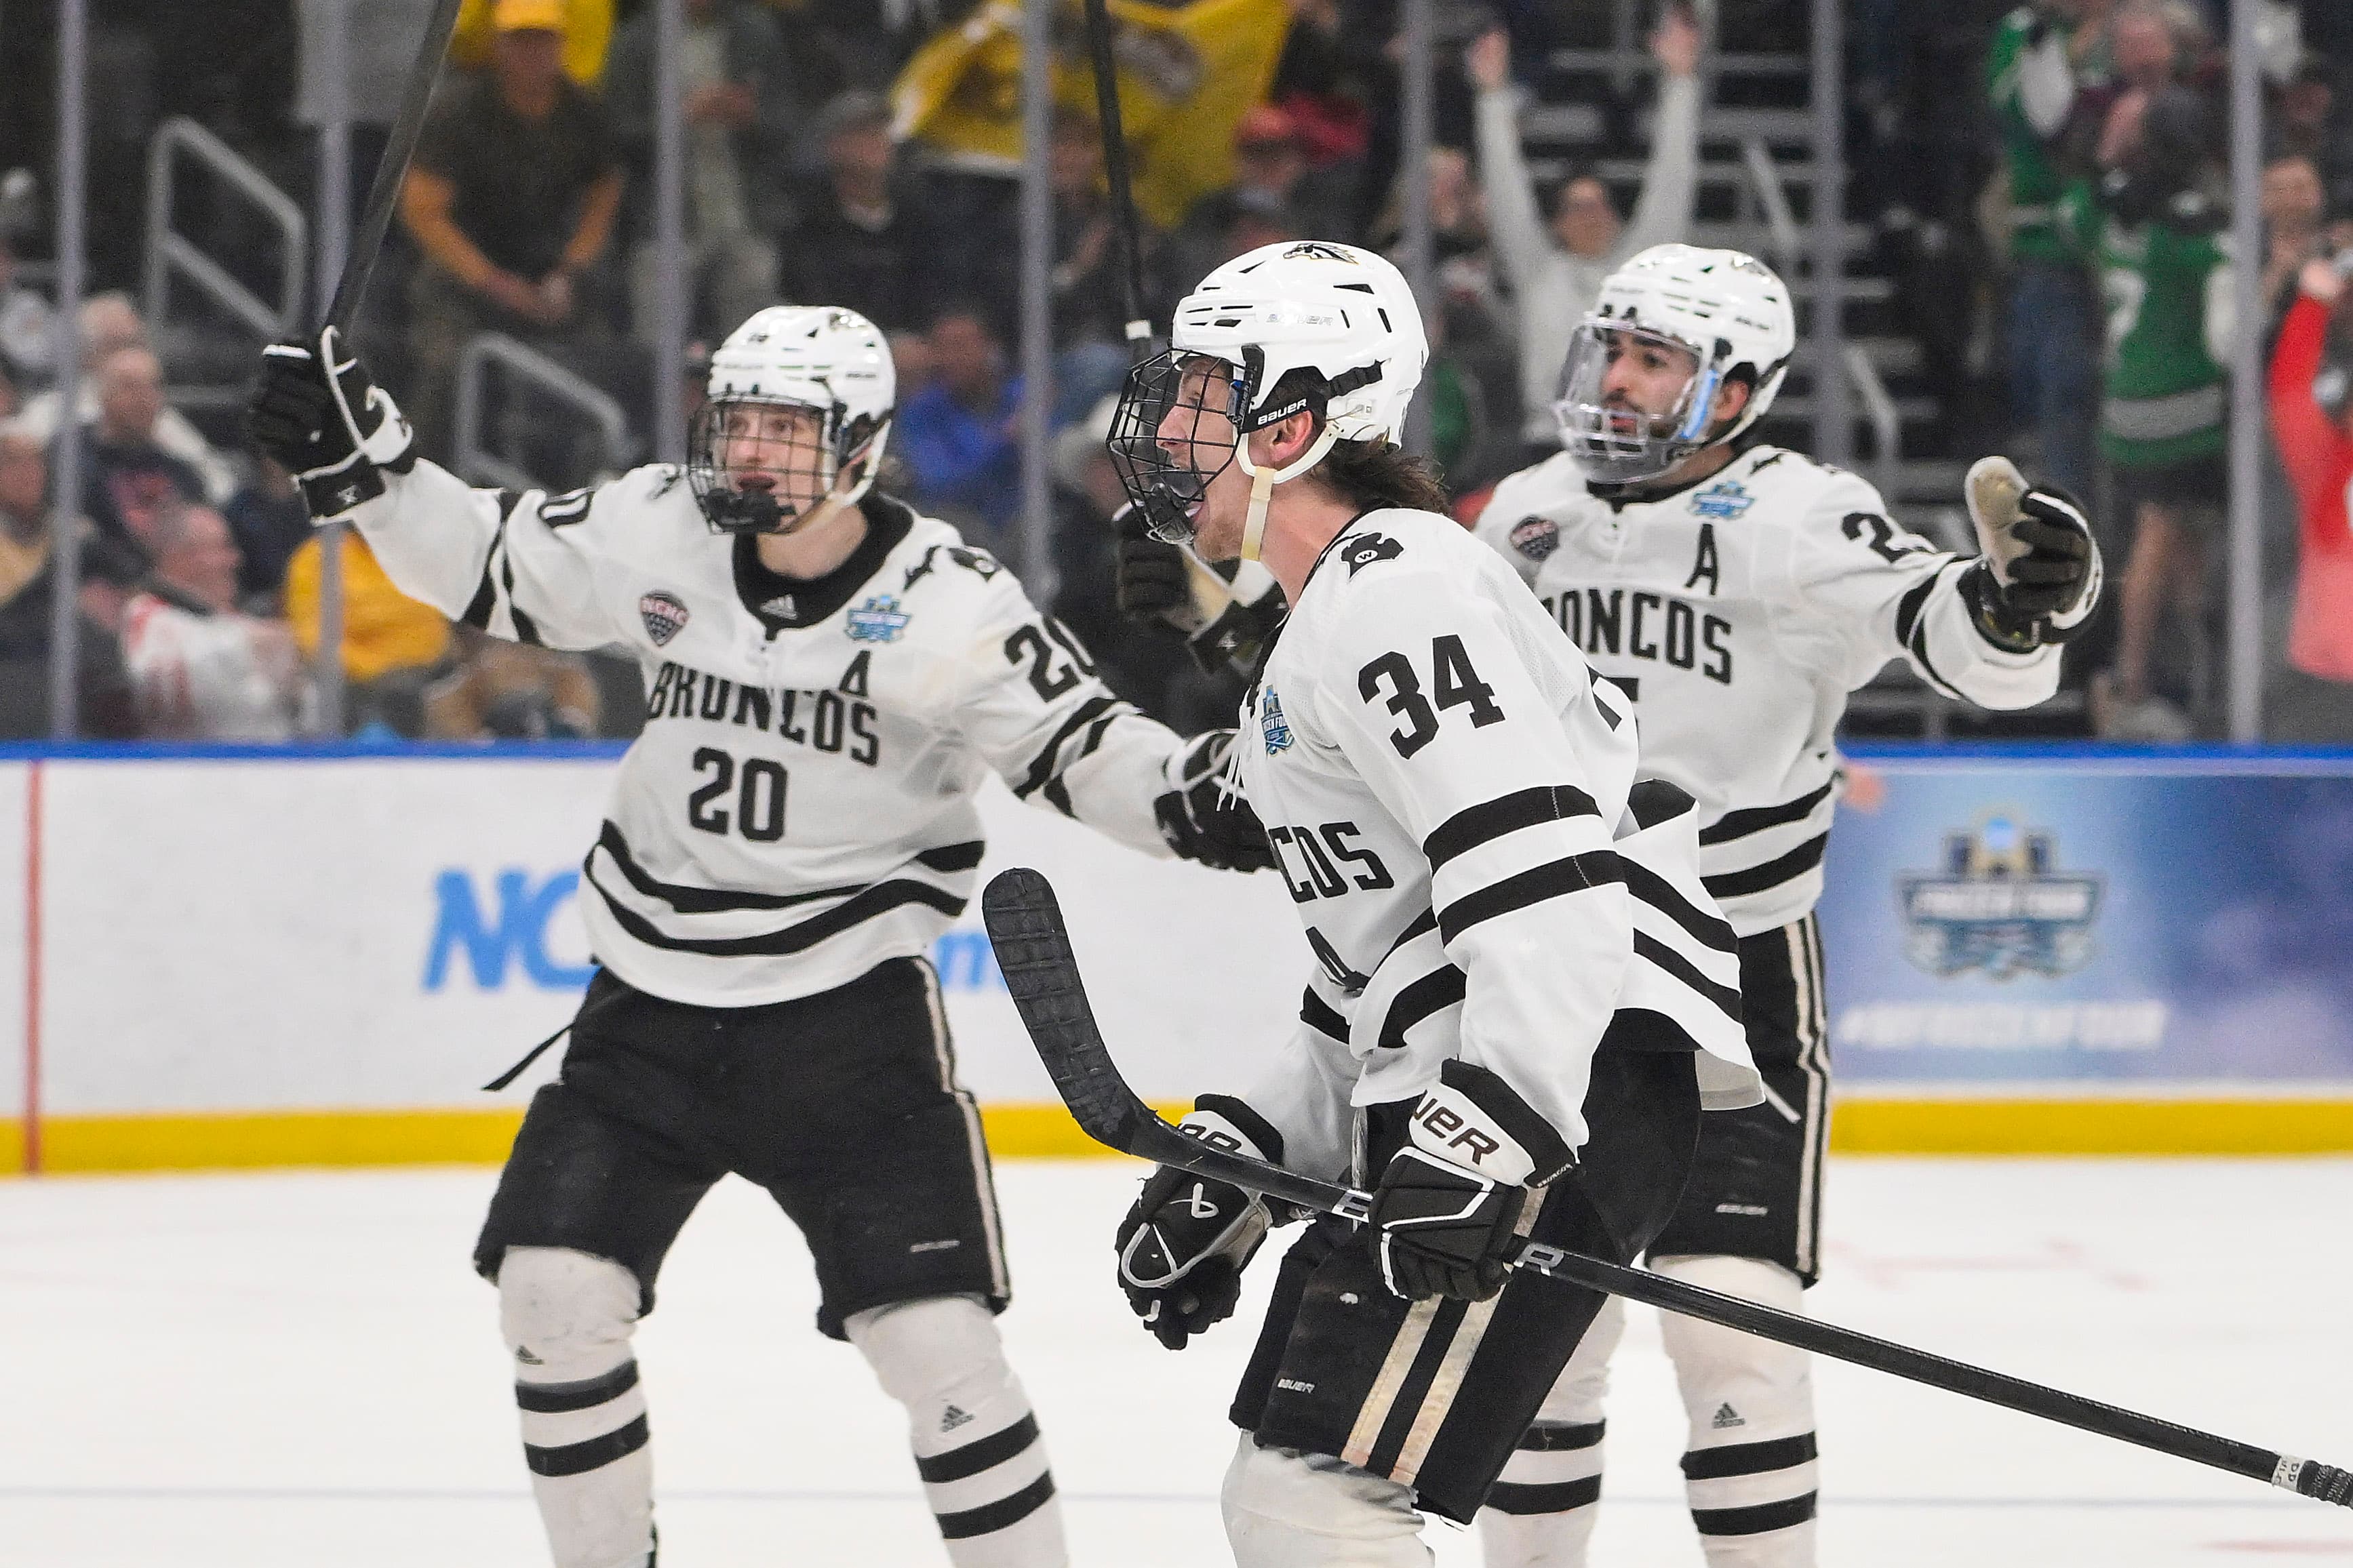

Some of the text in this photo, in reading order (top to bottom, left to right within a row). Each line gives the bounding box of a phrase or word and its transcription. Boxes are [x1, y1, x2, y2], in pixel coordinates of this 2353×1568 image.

[1257, 398, 1307, 426] BAUER
[1684, 523, 1721, 595] A
[1540, 588, 1734, 686] ONCOS
[646, 660, 881, 767] BRONCOS
[1357, 633, 1507, 760] 34
[688, 746, 788, 843] 20
